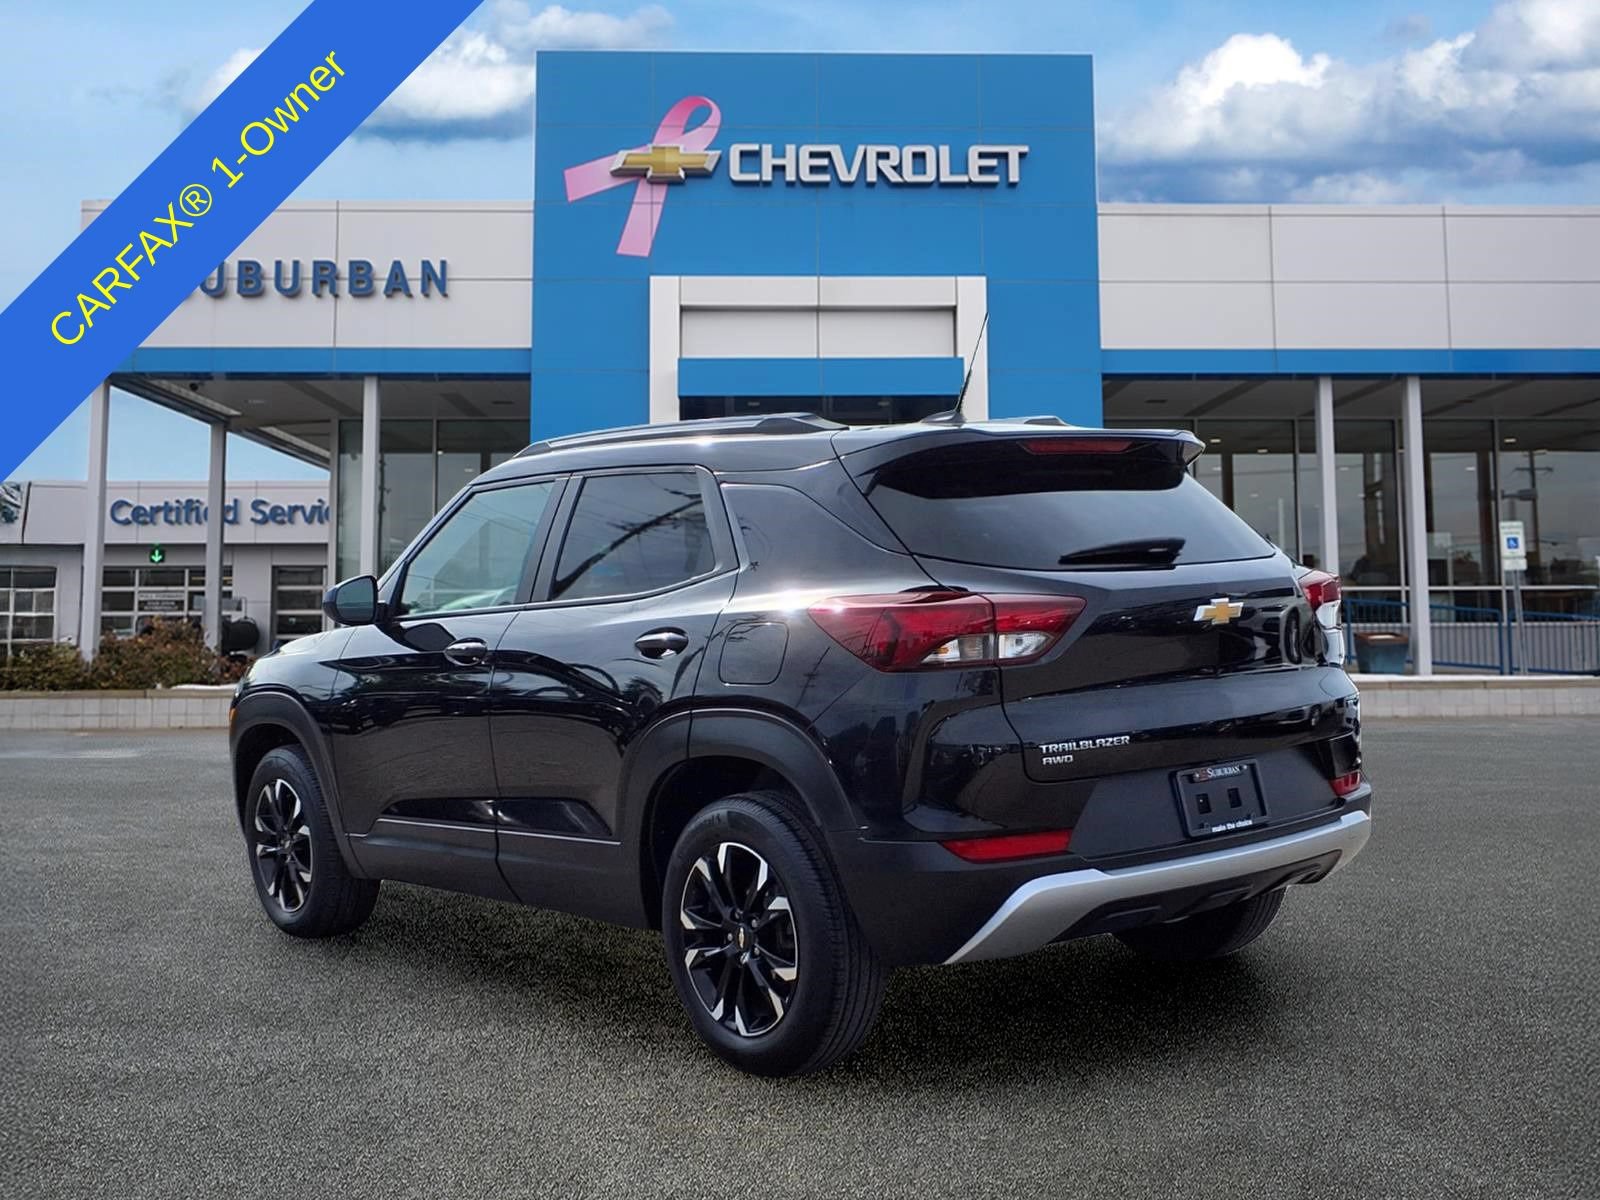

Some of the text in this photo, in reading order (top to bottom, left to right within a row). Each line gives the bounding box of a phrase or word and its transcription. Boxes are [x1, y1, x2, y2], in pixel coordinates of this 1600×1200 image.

[728, 143, 1029, 186] CHEVROLET
[200, 259, 448, 298] UBURBAN
[110, 498, 330, 525] Certifid Servi
[1039, 735, 1130, 753] TRAILBLAZER
[1042, 754, 1073, 765] AWD
